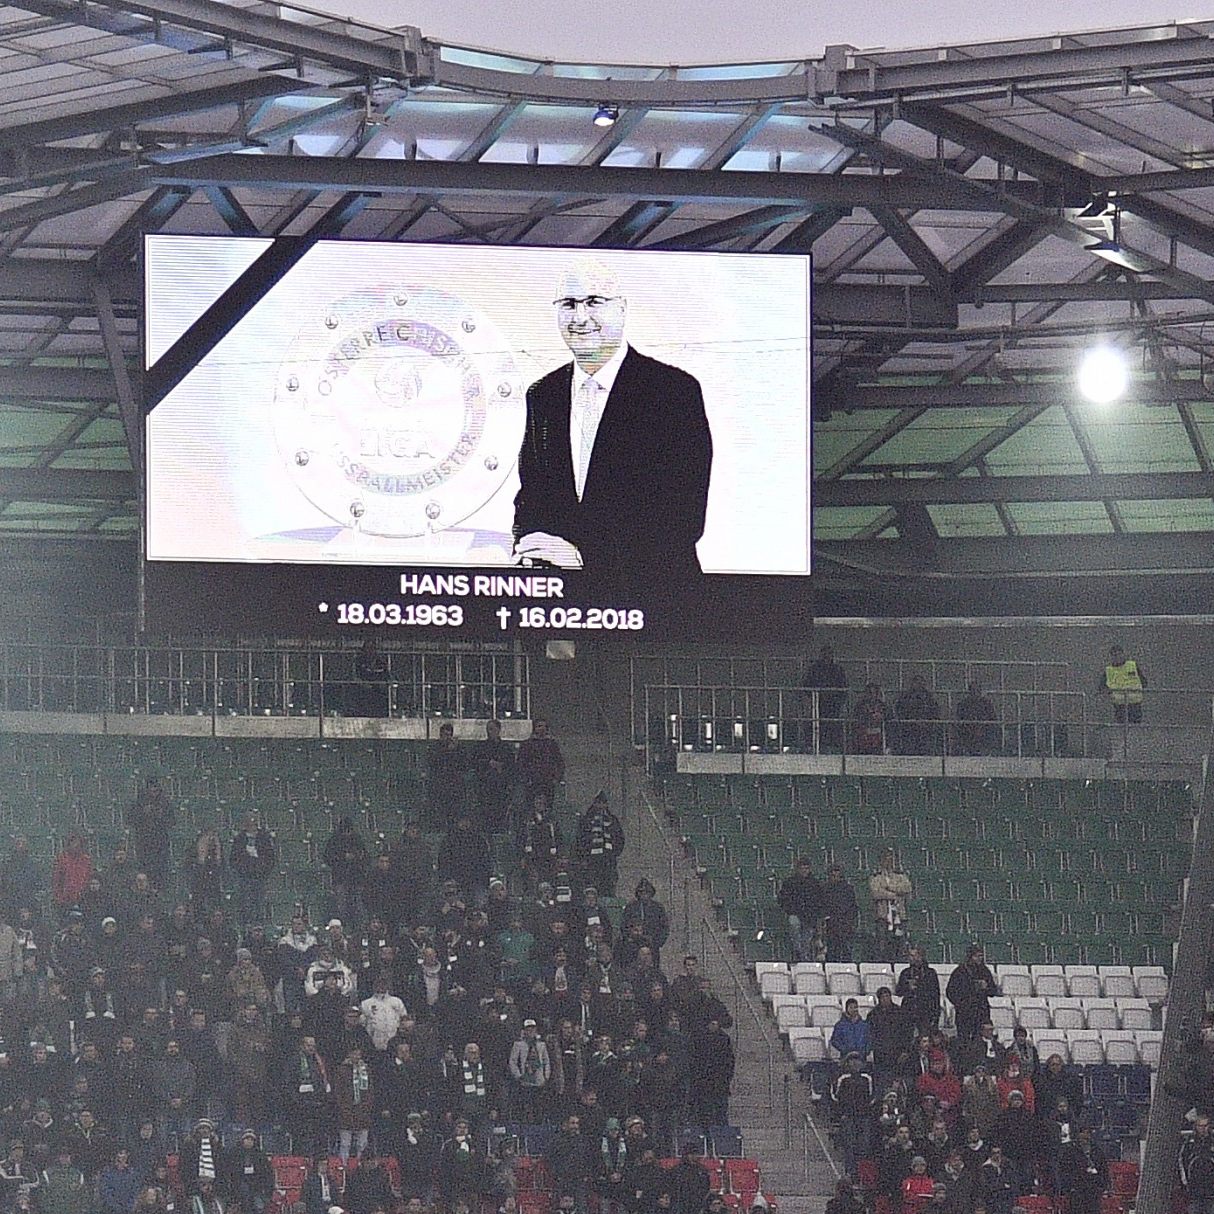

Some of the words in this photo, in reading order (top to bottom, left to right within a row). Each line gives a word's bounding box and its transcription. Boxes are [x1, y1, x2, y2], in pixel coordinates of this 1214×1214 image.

[400, 574, 470, 596] HANS
[475, 577, 564, 598] RINNER
[337, 603, 464, 626] 18.03.1963
[518, 607, 644, 630] 16.02.2018
